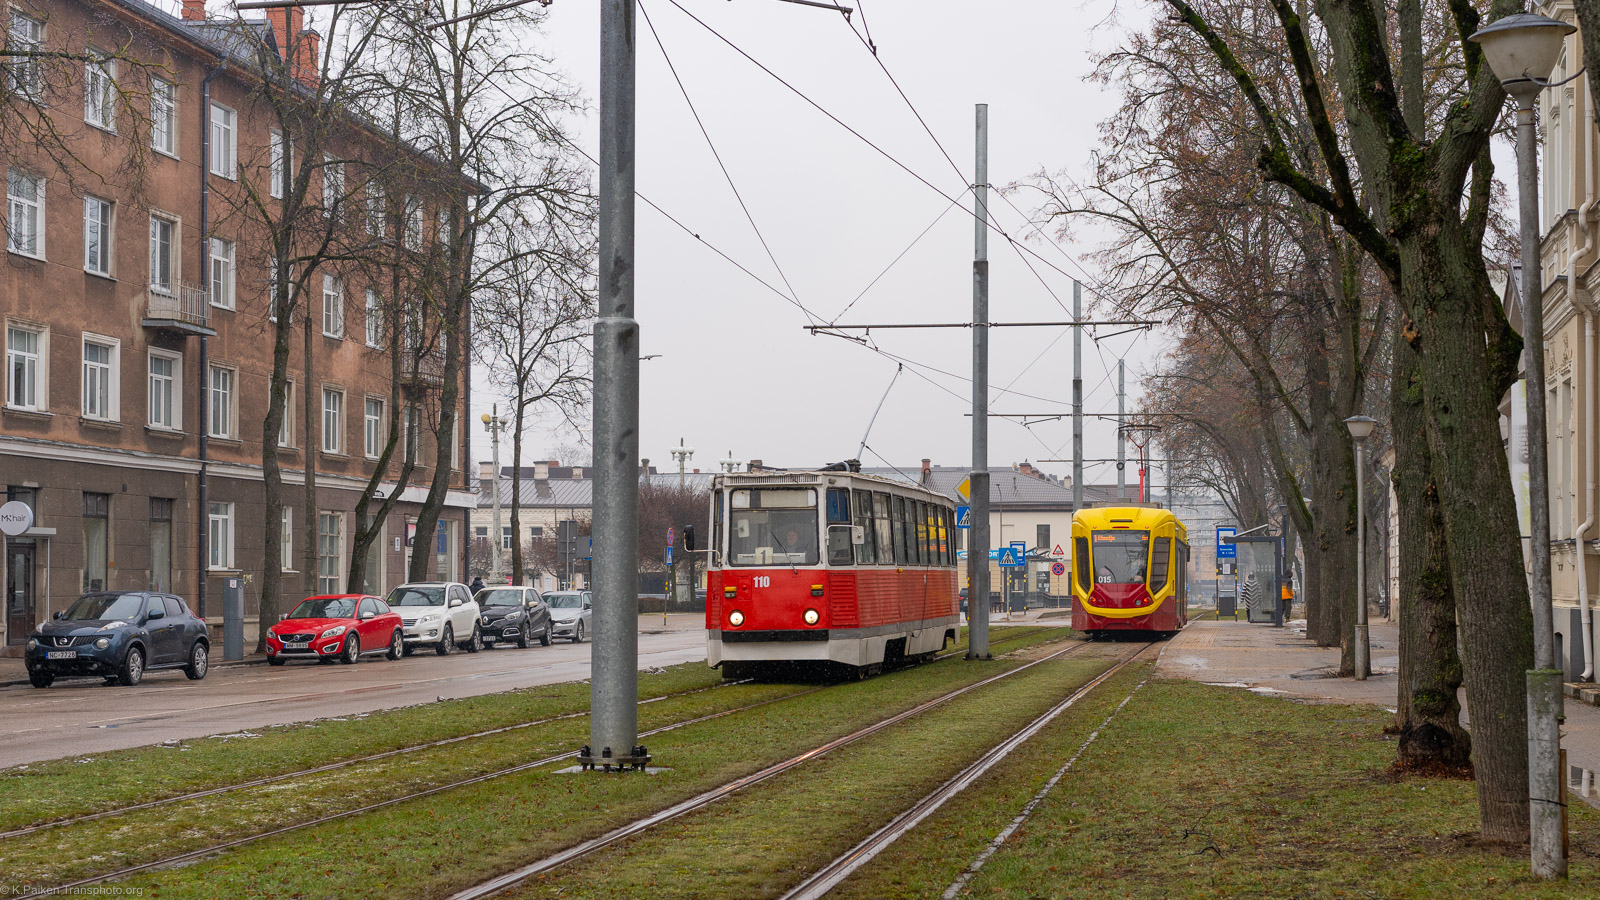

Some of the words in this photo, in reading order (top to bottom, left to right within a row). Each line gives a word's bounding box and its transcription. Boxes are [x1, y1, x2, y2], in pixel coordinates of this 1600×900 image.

[760, 549, 766, 565] 1
[753, 576, 770, 588] 110
[1098, 576, 1112, 584] 015
